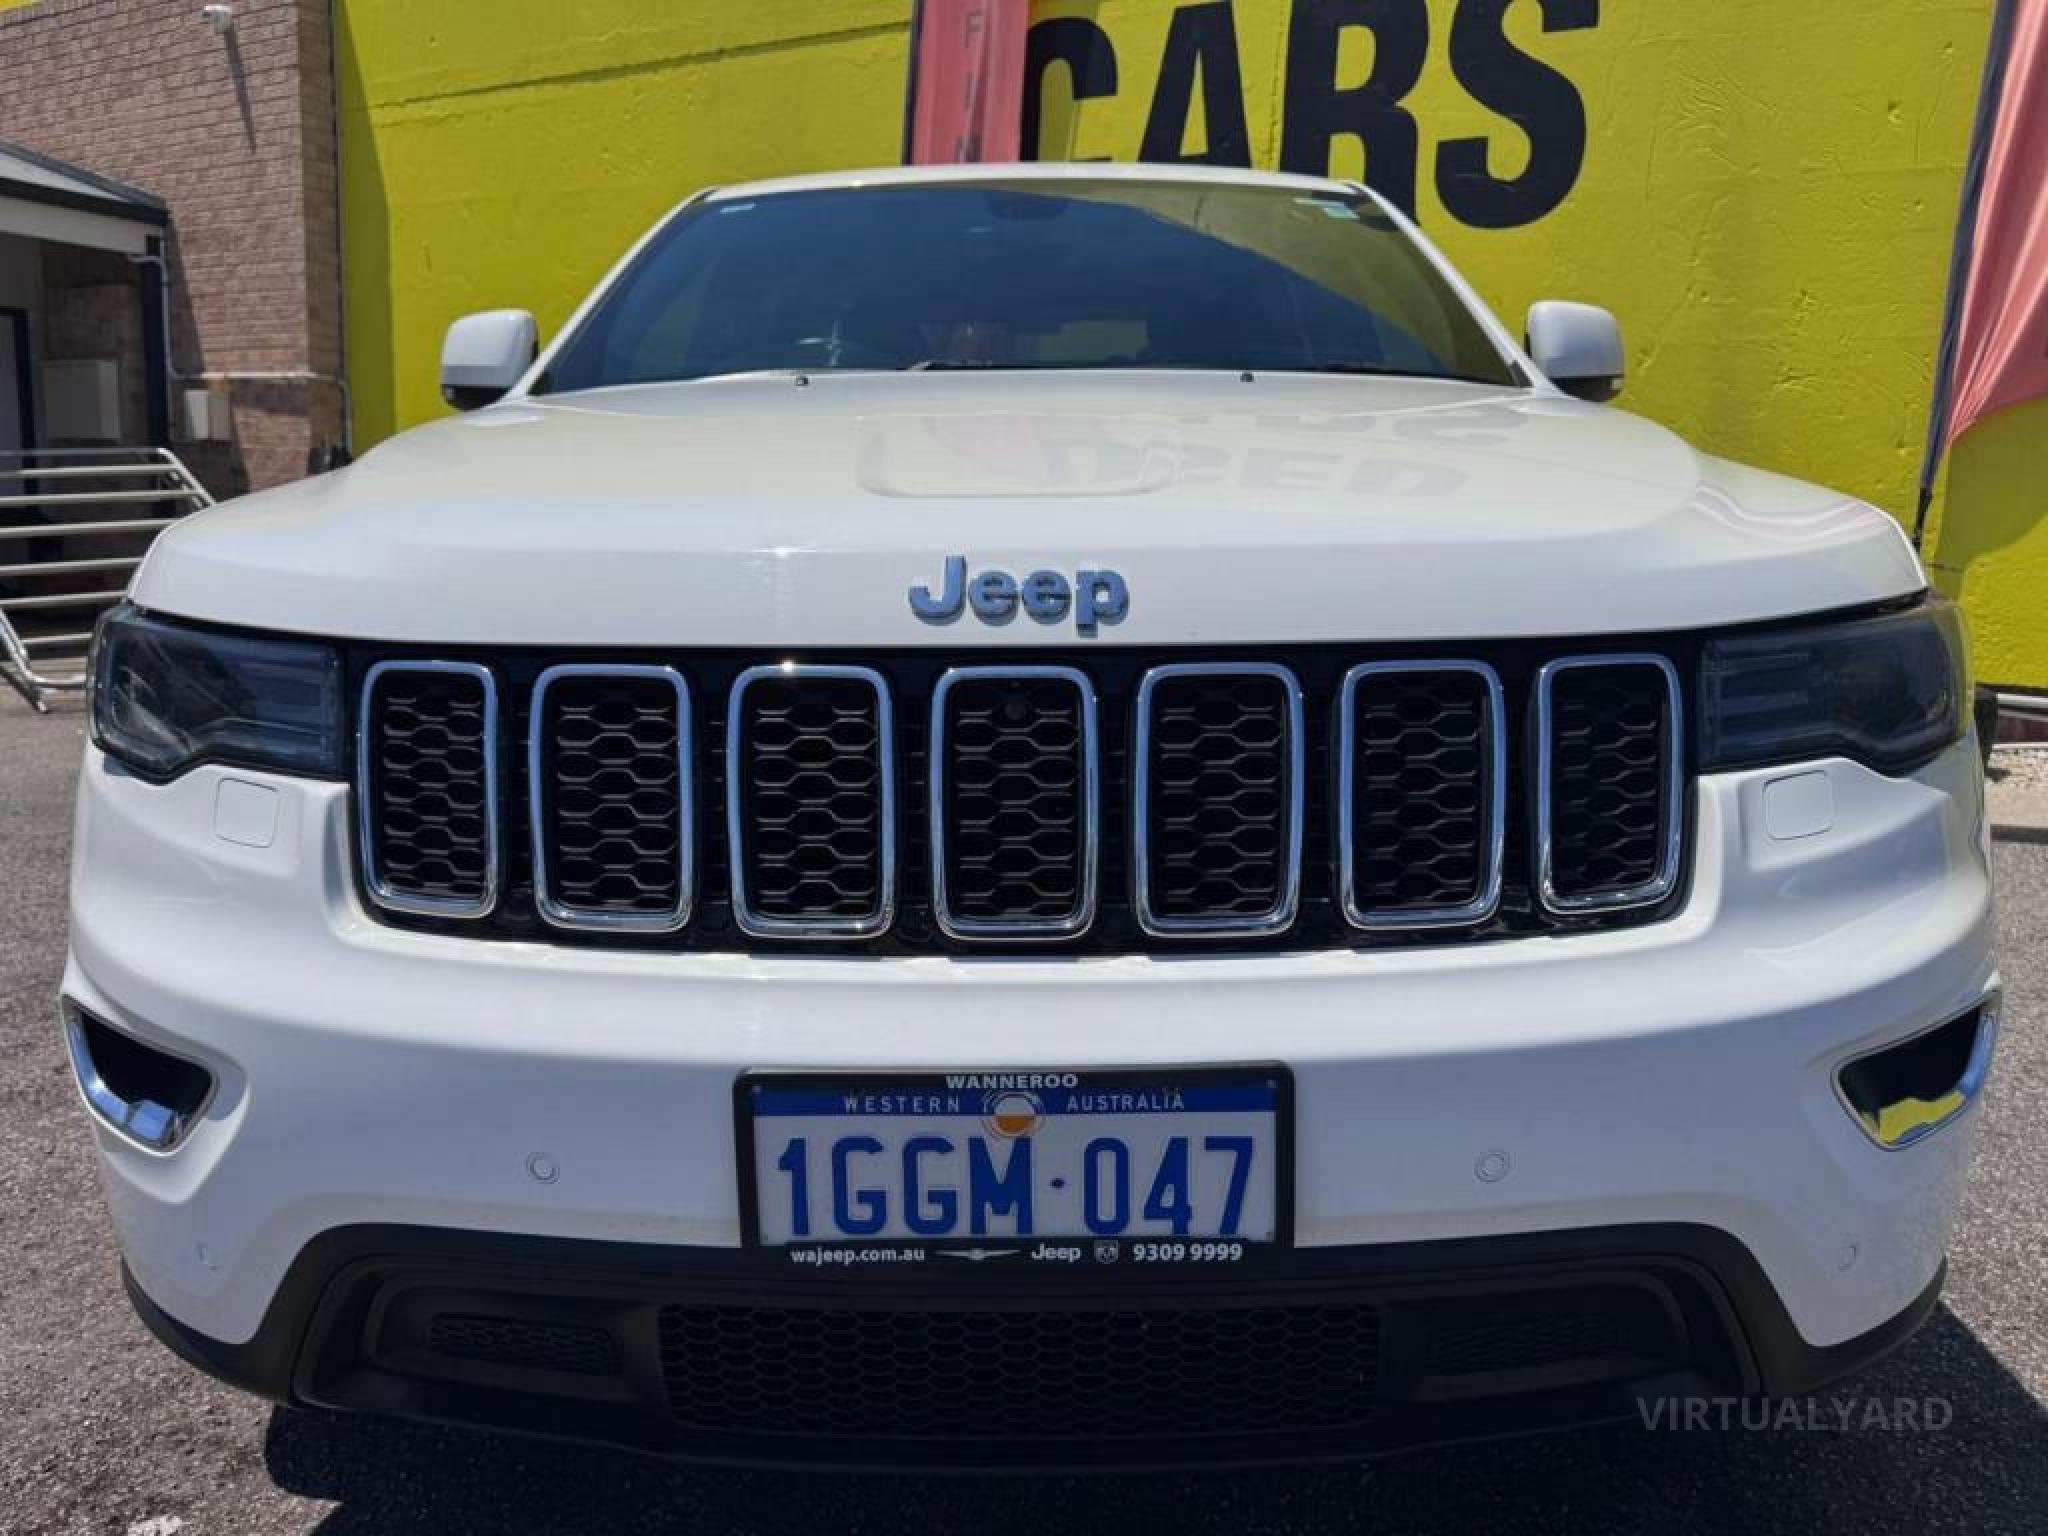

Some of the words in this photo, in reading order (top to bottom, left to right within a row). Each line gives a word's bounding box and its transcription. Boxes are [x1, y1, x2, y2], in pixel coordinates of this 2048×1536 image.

[1020, 0, 1599, 230] CARS
[909, 556, 1129, 636] Jeep
[946, 1074, 1078, 1089] WANNEROO
[844, 1096, 960, 1113] WESTERN
[1067, 1094, 1185, 1112] AUSTRALIA
[790, 1246, 926, 1266] wajeep.com.au
[1031, 1243, 1081, 1263] Jeep
[1134, 1243, 1185, 1261] 9309
[1191, 1243, 1243, 1261] 9999
